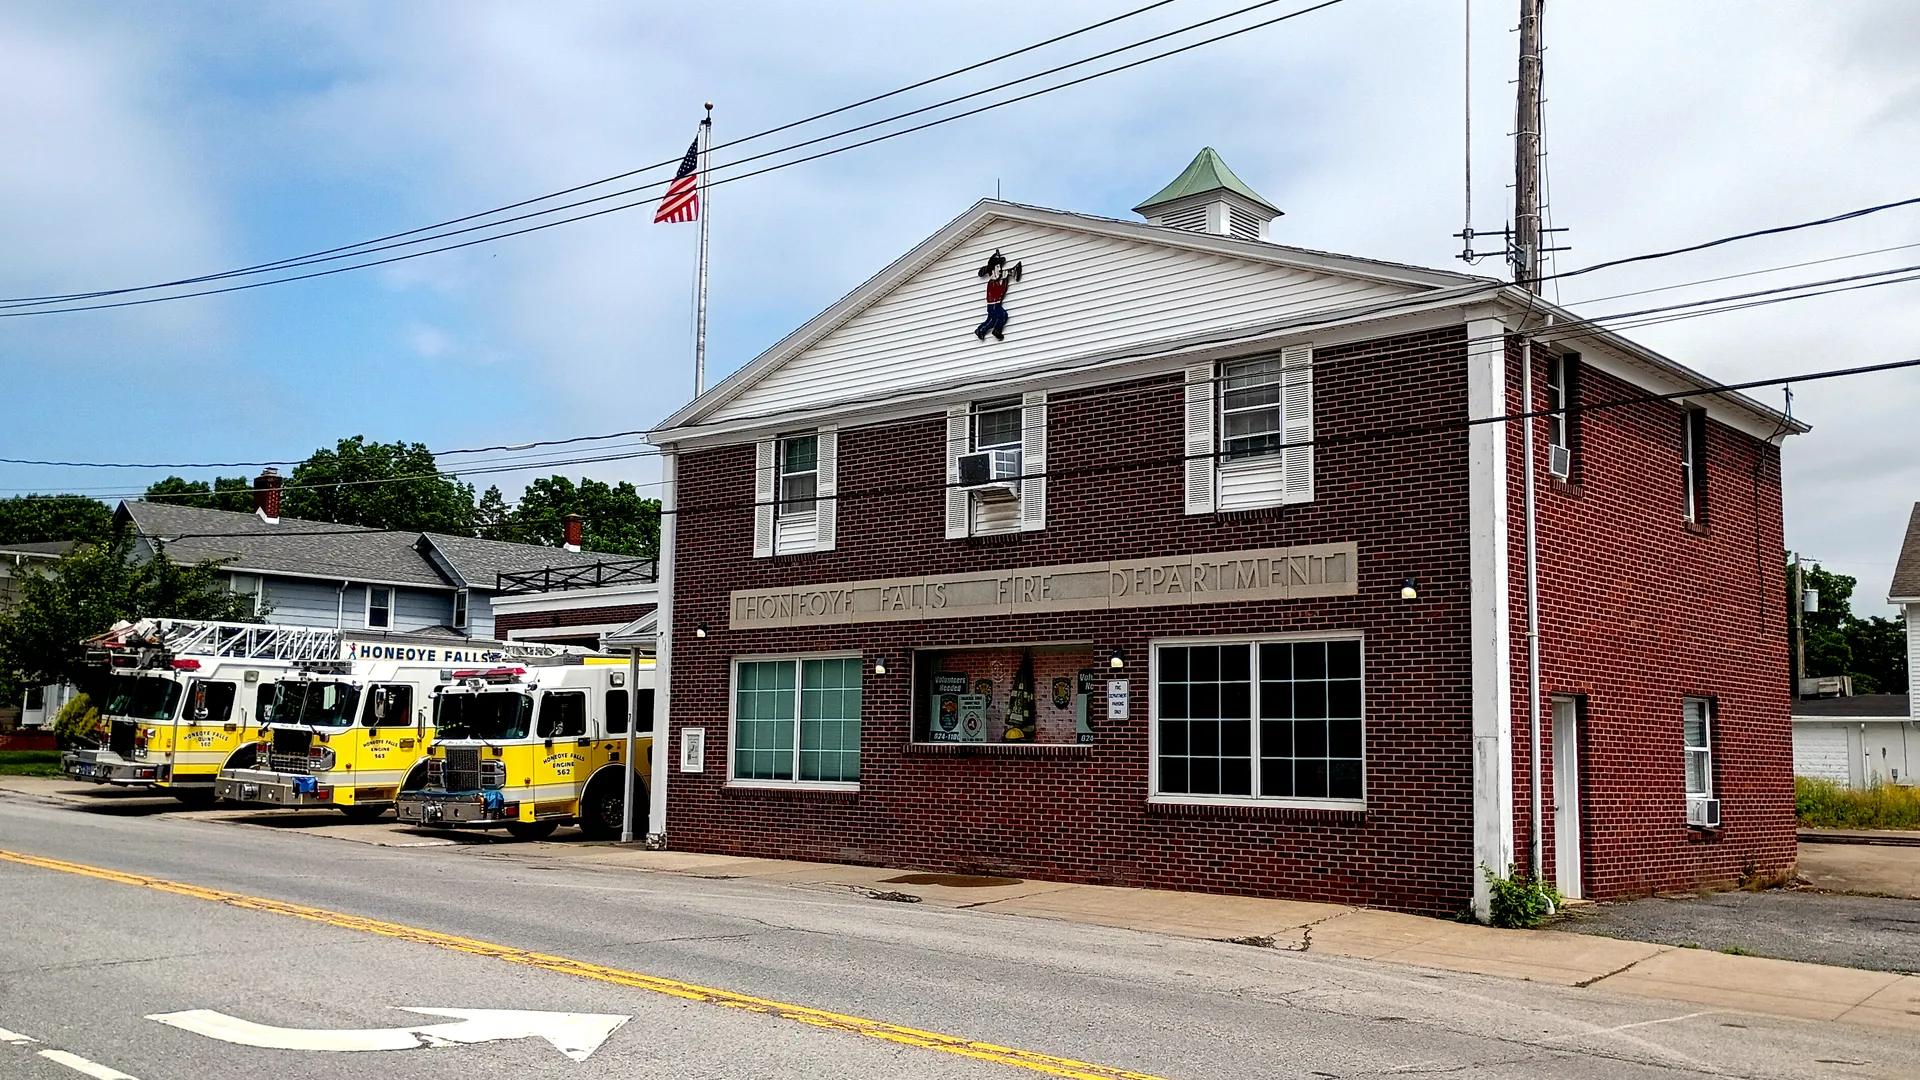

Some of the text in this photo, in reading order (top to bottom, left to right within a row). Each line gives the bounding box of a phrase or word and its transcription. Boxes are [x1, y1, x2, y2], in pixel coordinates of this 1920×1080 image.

[745, 554, 1337, 620] HONEOYE FALLS FIRE DEPARTMENT
[360, 644, 489, 663] HONEOYE FALLS
[212, 731, 228, 741] FALLS
[543, 753, 585, 764] HONEOYE FALLS
